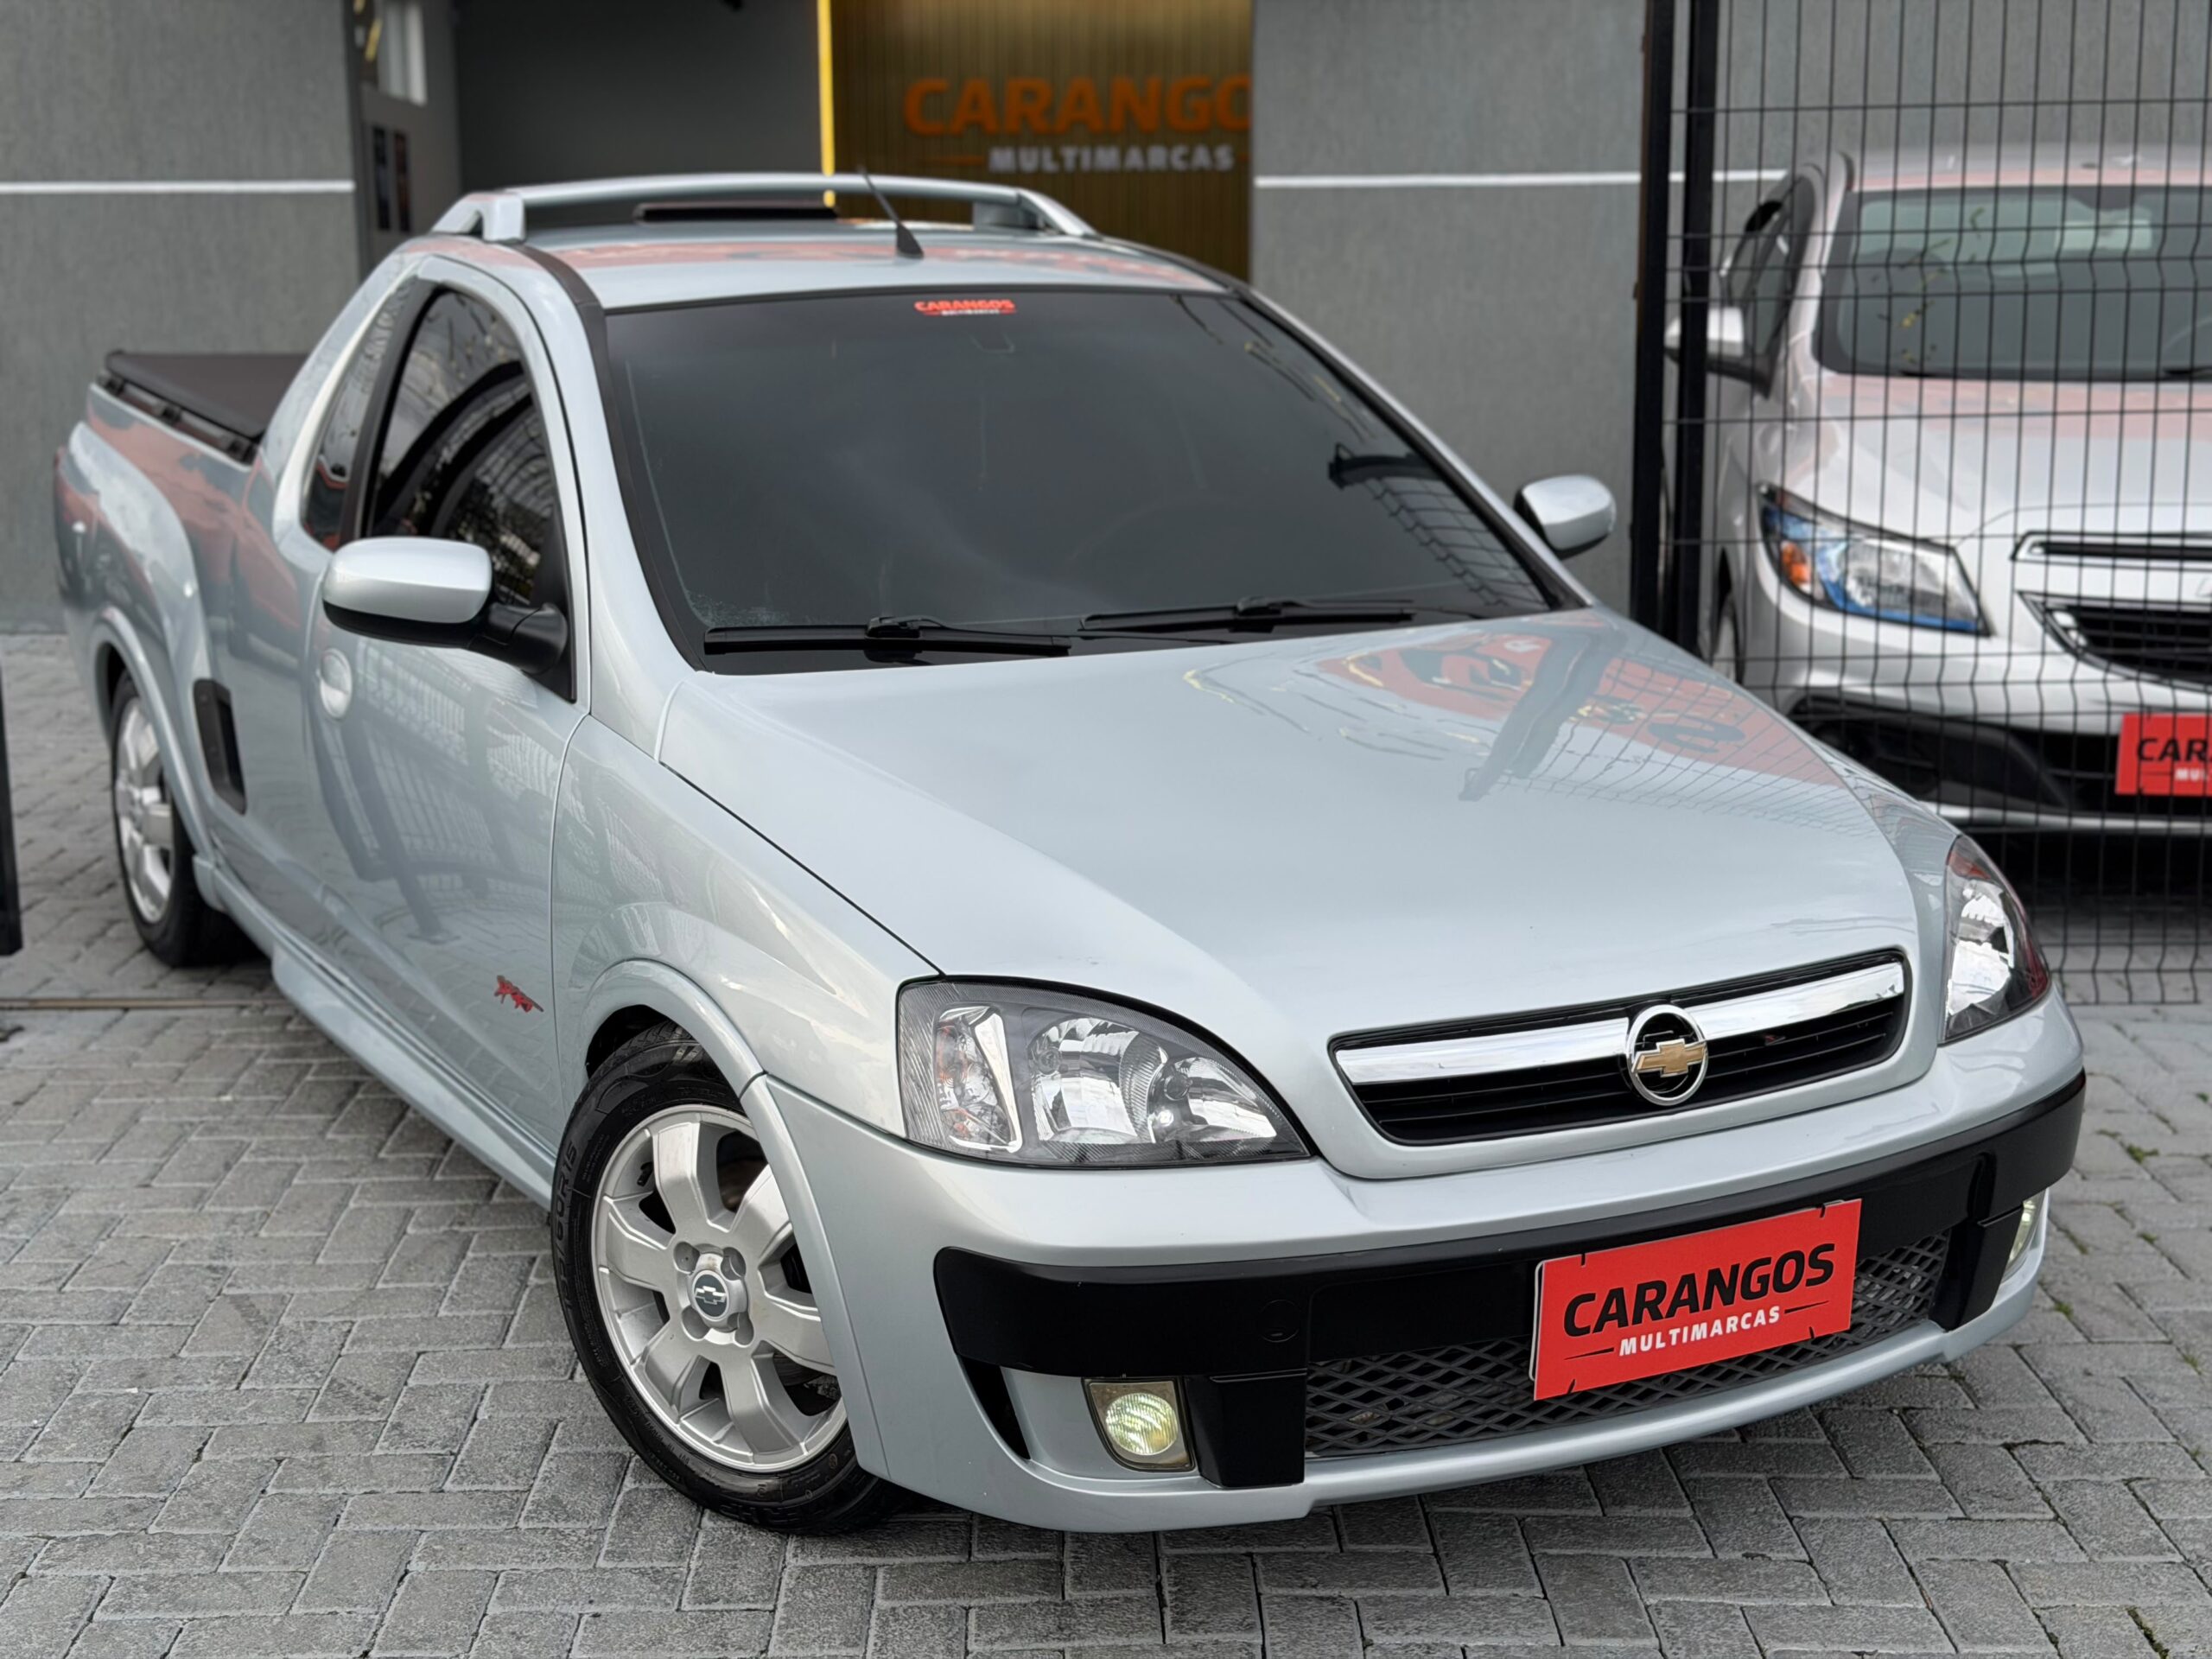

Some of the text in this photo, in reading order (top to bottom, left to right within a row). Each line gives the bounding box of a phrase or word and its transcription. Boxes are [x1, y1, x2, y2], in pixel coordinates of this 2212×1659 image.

[988, 145, 1236, 172] MULTIMARCAS
[2137, 738, 2212, 762] CAR
[1564, 1243, 1835, 1338] CARANGOS
[1619, 1306, 1781, 1357] MULTIMARCAS
